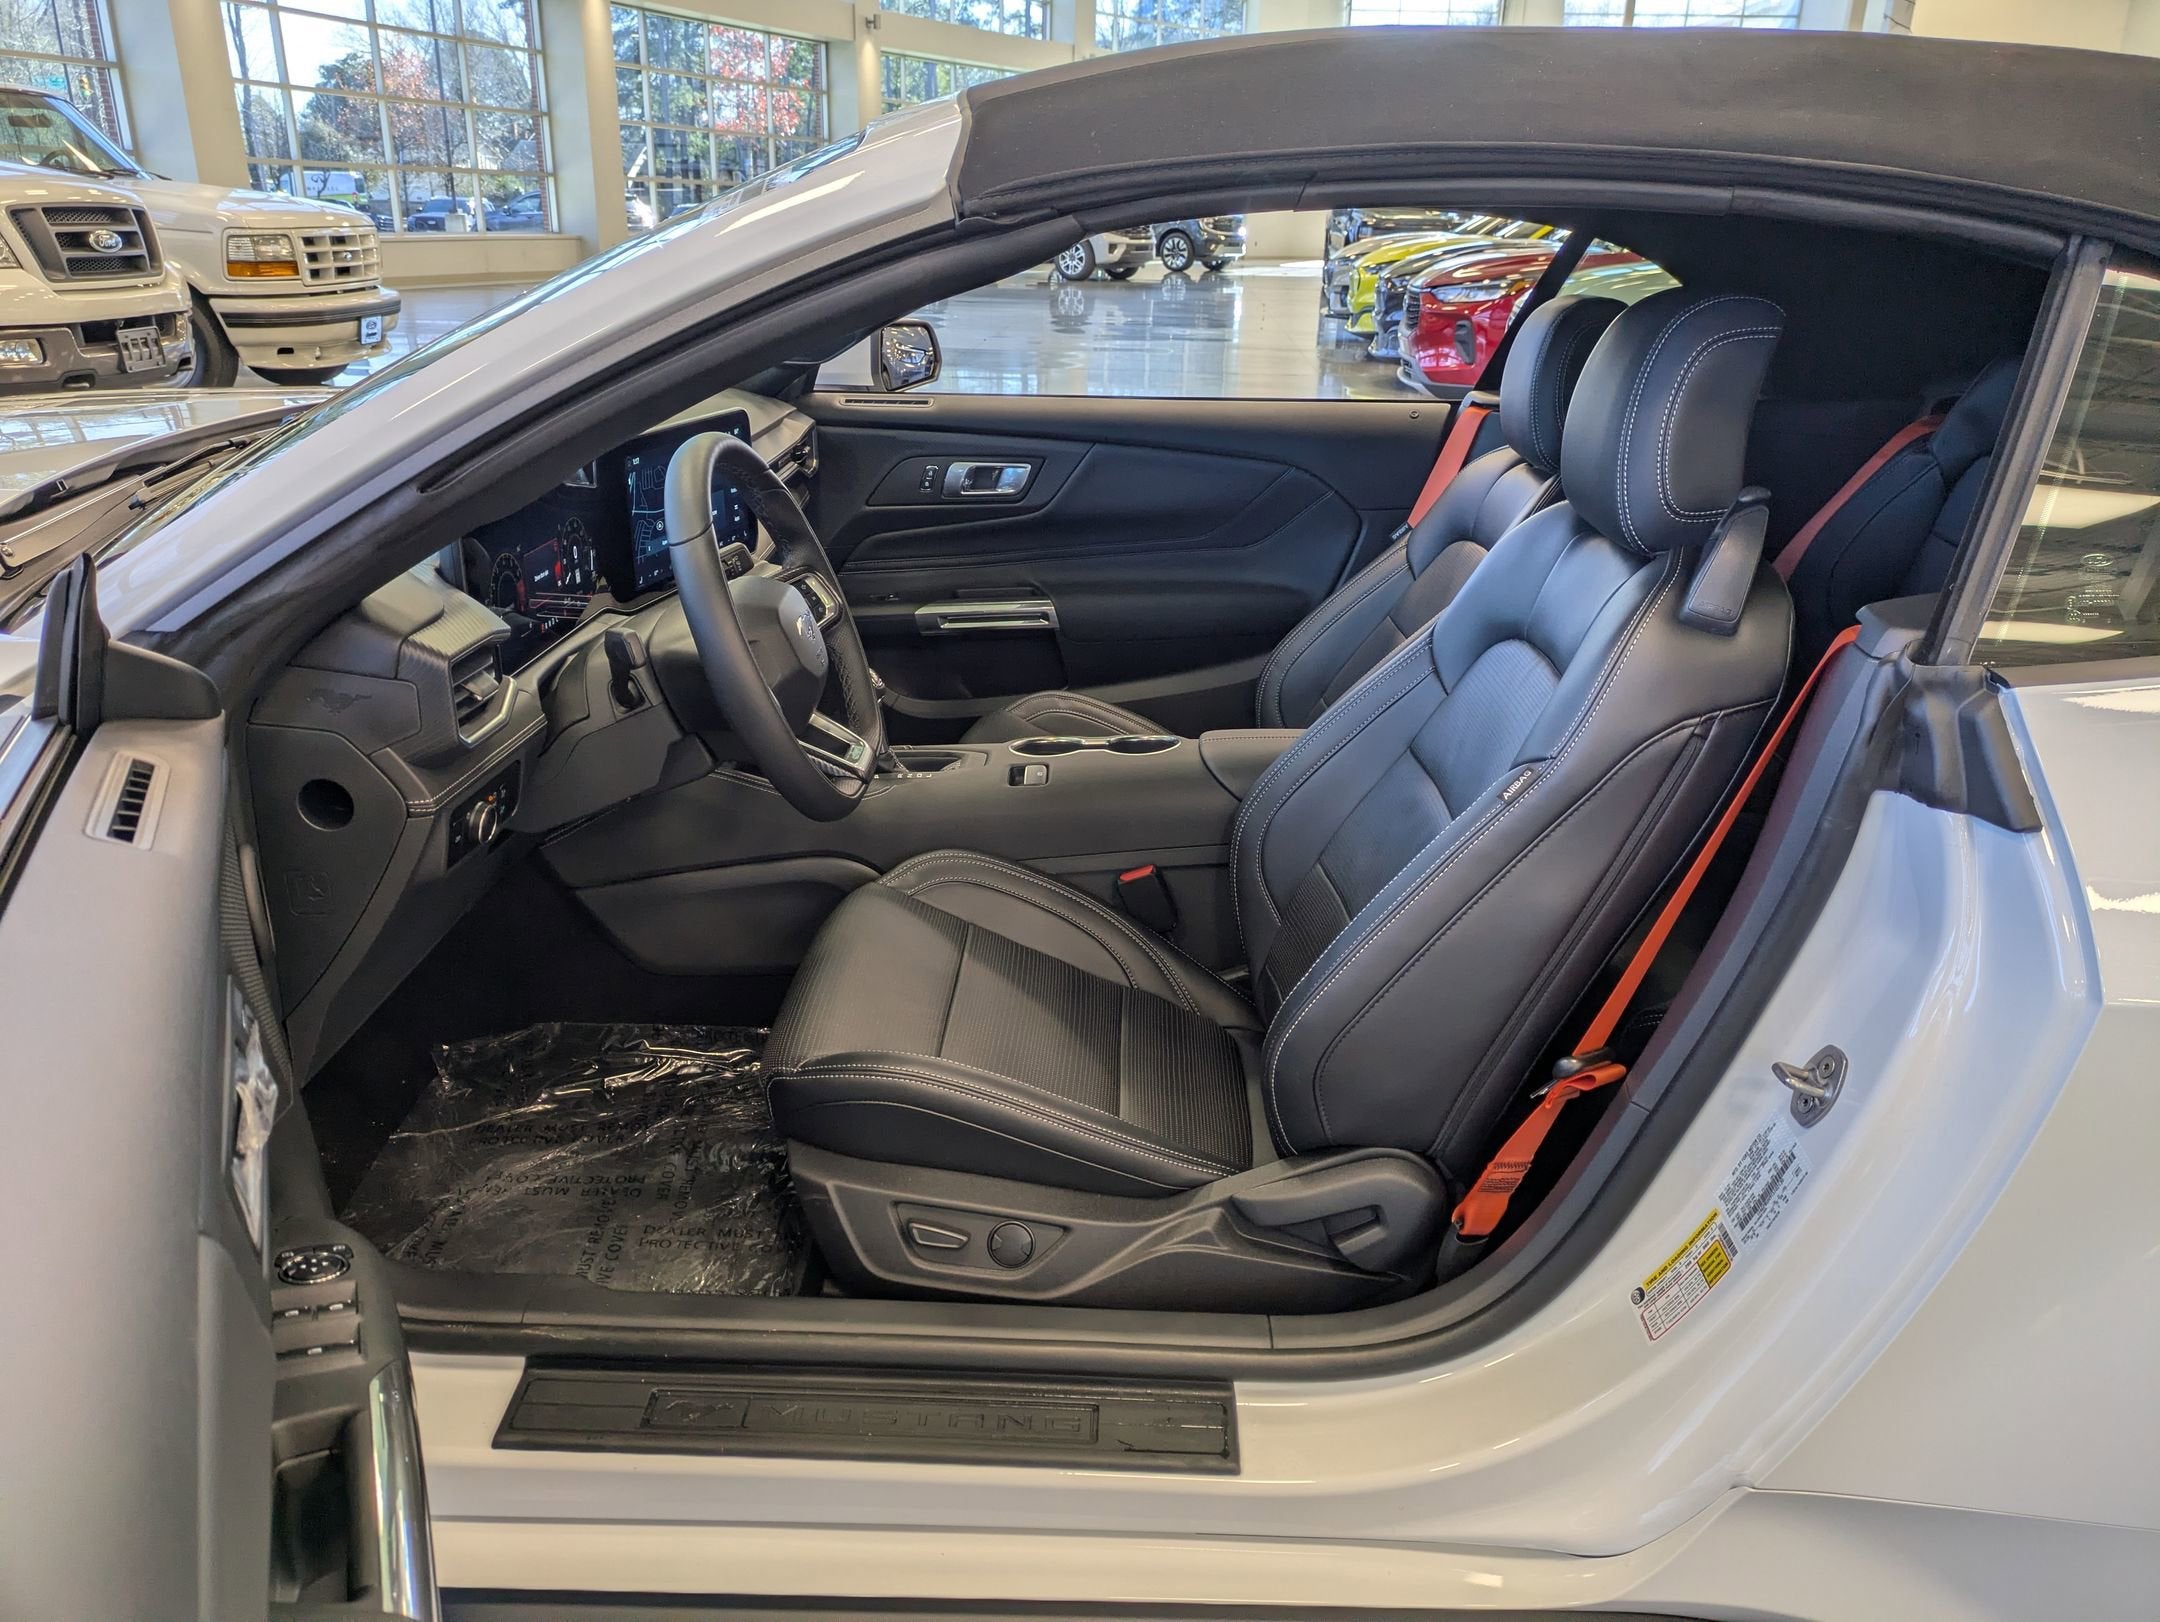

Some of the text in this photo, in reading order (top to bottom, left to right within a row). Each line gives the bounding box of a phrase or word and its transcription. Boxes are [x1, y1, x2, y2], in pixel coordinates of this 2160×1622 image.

[1503, 770, 1532, 800] AIRBAG
[543, 1122, 589, 1132] MUST
[470, 1135, 562, 1145] PROTECIVE
[550, 1174, 646, 1184] PROTECTIVE
[524, 1187, 570, 1197] MUST
[643, 1224, 706, 1238] DEALER
[718, 1228, 764, 1240] MUST
[638, 1239, 741, 1252] PROTECTIVE
[1646, 1274, 1656, 1287] TIRE
[1657, 1264, 1667, 1276] AND
[1667, 1244, 1688, 1266] LOADING
[1686, 1211, 1719, 1245] INFORMATION
[762, 1403, 1082, 1433] MUSTANG
